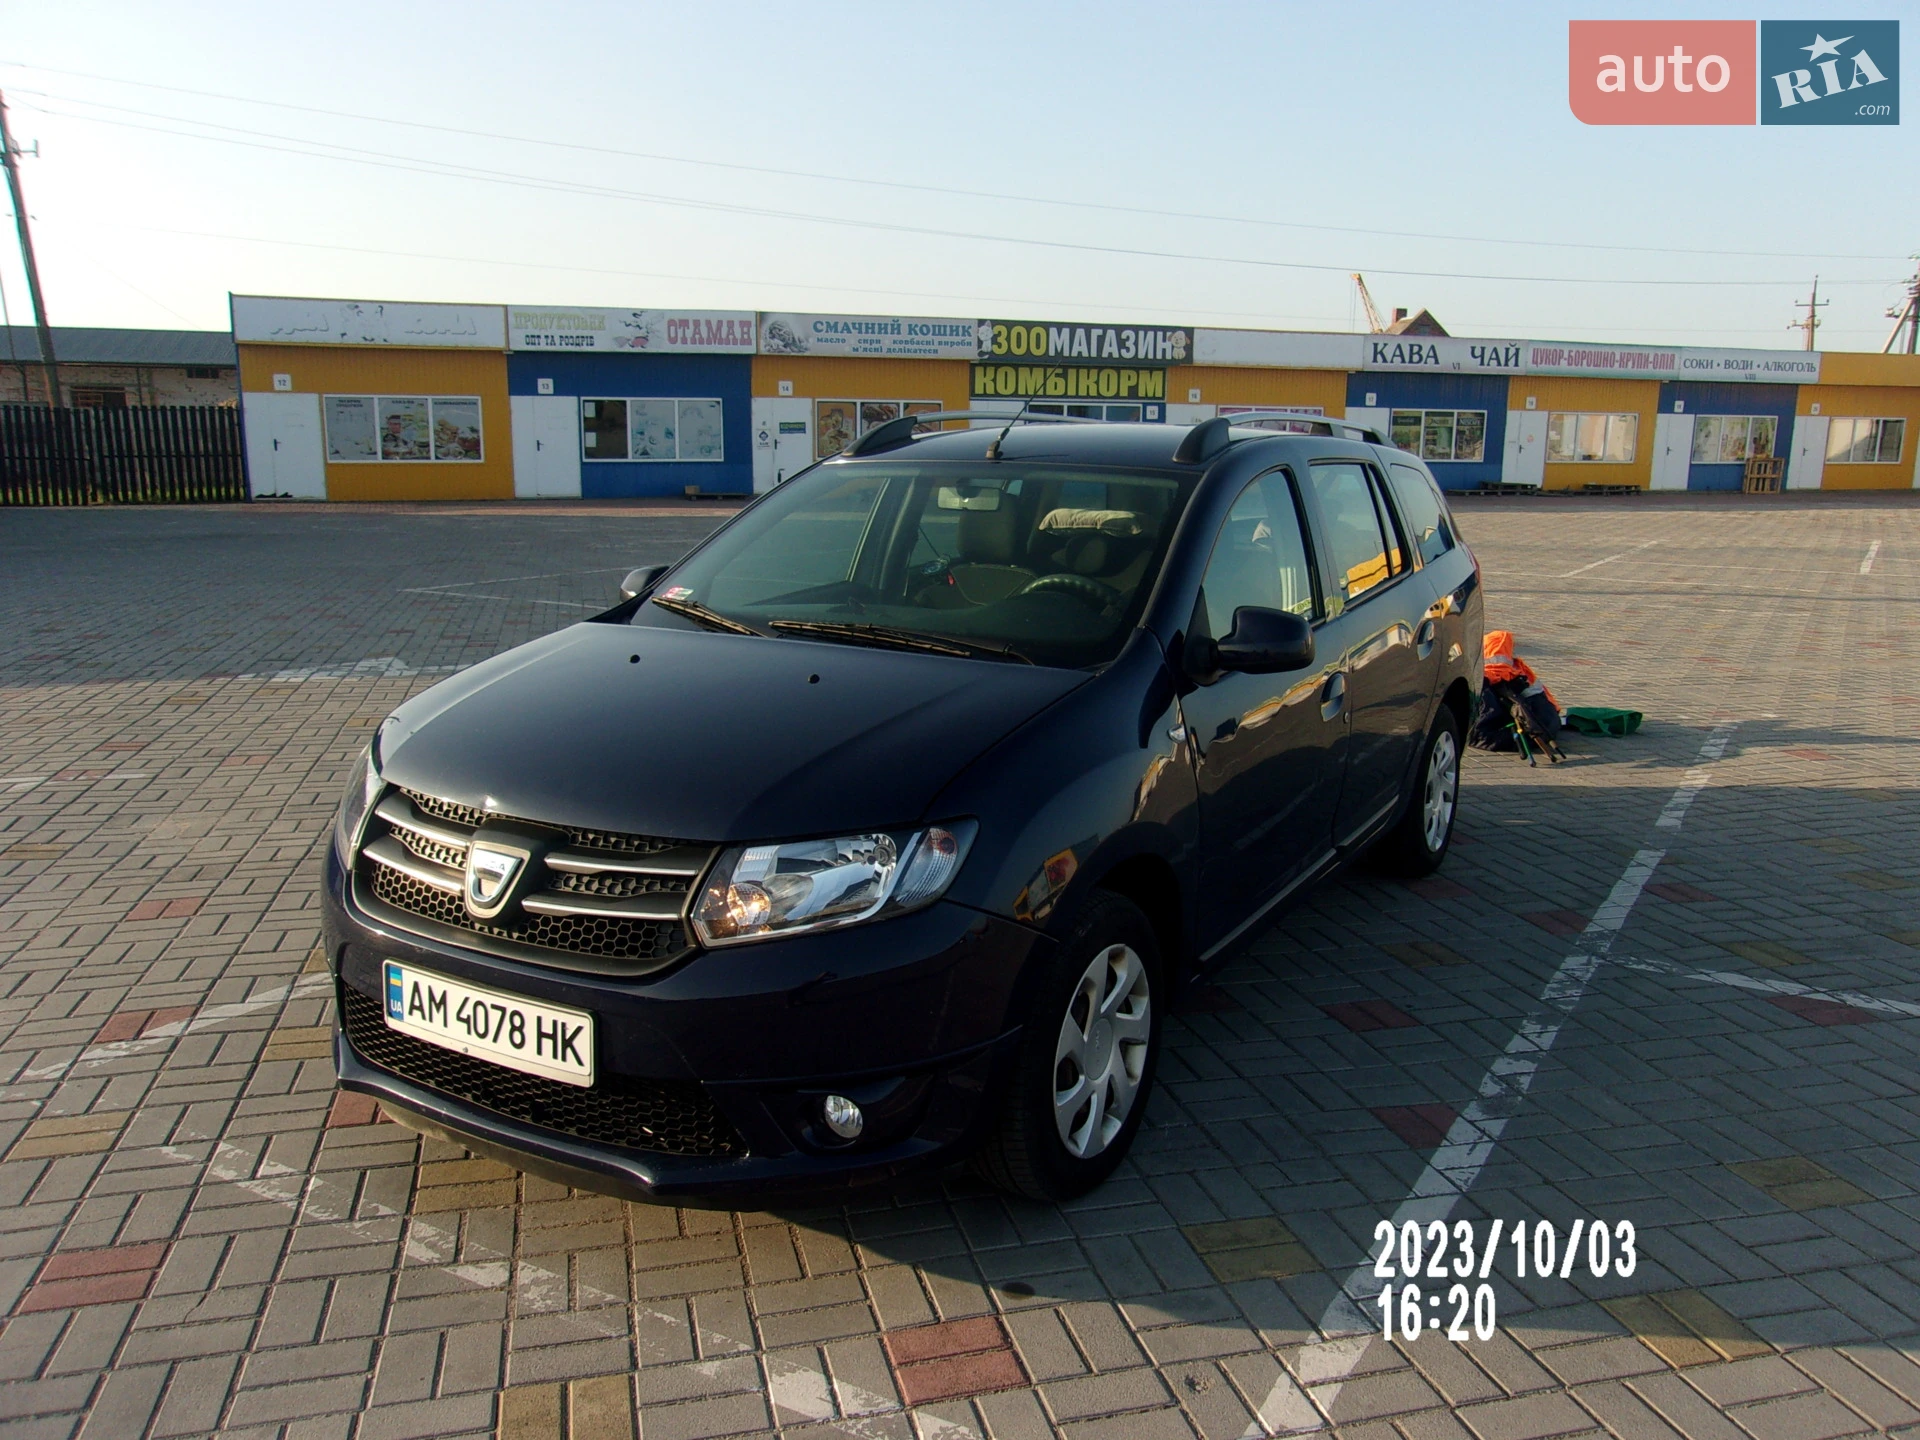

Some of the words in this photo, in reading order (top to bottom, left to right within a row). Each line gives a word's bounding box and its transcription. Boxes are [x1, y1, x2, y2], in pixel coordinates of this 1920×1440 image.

[667, 319, 753, 346] ОТАМАН
[813, 319, 902, 336] СМАЧНИЙ
[907, 322, 973, 337] КОШИК
[525, 334, 541, 346] ОПТ
[544, 335, 556, 346] ТА
[559, 335, 595, 347] РОЗДРІБ
[816, 336, 847, 344] масло
[892, 338, 935, 346] ковбасні
[938, 339, 973, 347] вироби
[992, 324, 1172, 360] ЗООМАГАЗИН
[886, 347, 939, 355] делікатеси
[1372, 342, 1440, 366] КАВА
[1470, 342, 1520, 367] ЧАЙ
[1683, 358, 1713, 370] СОКИ
[1723, 359, 1753, 371] ВОДИ
[1762, 360, 1817, 373] АЛКОГОЛЬ
[277, 378, 287, 387] 12
[974, 366, 1163, 398] КОМБІКОРМ
[391, 1000, 403, 1014] UA
[408, 980, 448, 1028] AM
[456, 996, 526, 1050] 4078
[536, 1015, 585, 1067] HK
